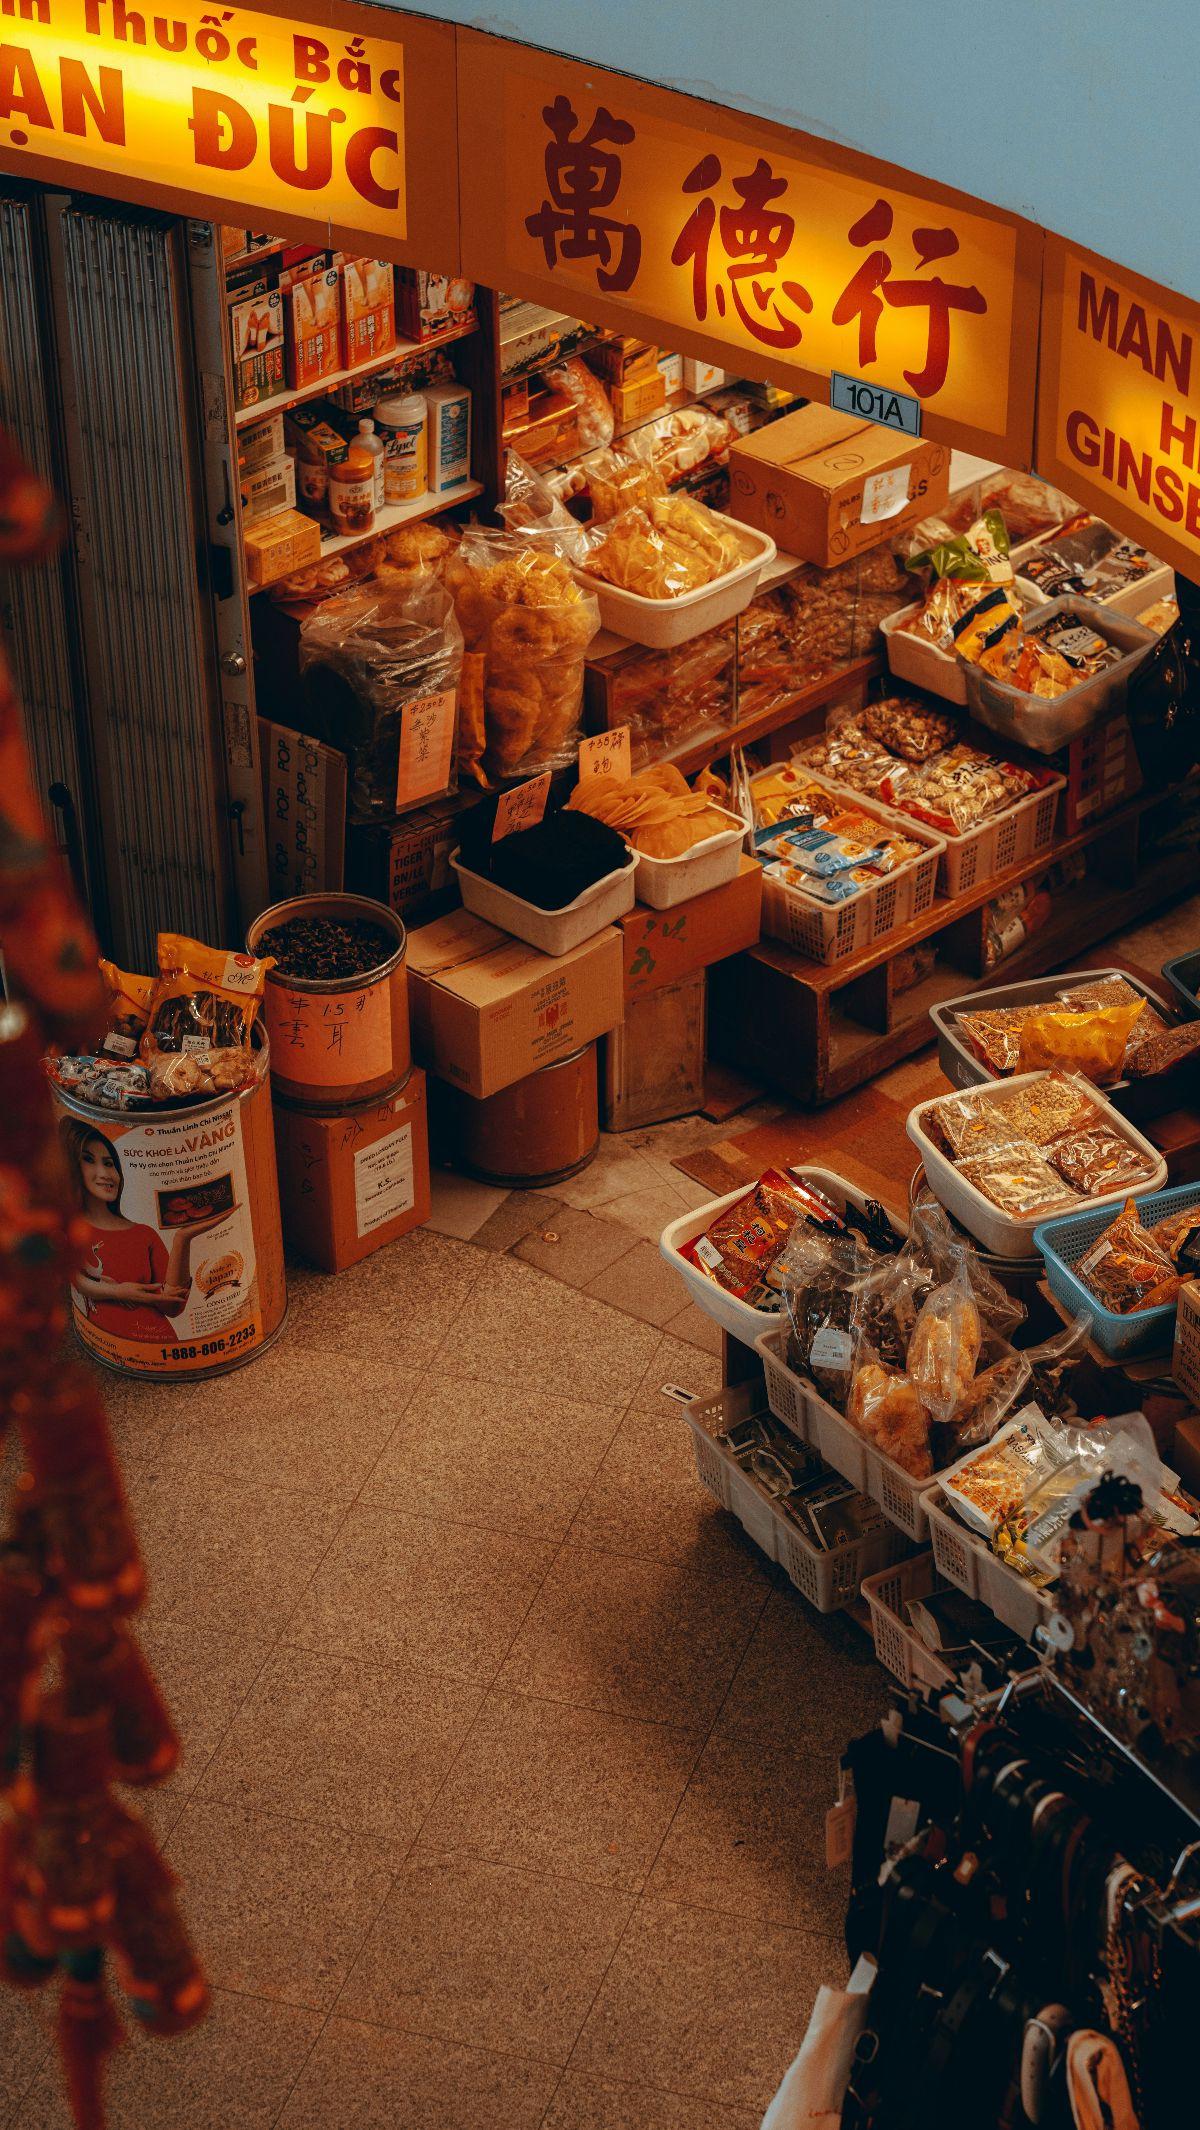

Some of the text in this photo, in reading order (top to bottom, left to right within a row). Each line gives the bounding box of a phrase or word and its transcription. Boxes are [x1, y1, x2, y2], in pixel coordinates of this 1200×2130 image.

[293, 34, 400, 103] Bắc
[187, 84, 400, 210] ĐỨC
[525, 95, 987, 398] 萬德行
[1077, 270, 1193, 398] MAN
[846, 384, 905, 427] 101A
[387, 436, 416, 454] Lysol
[1159, 400, 1200, 474] H
[276, 739, 290, 772] POP
[276, 788, 290, 821] POP
[296, 772, 308, 807] POP
[295, 820, 308, 852] POP
[275, 842, 289, 876] POP
[160, 1323, 256, 1361] 1-888-806-2233
